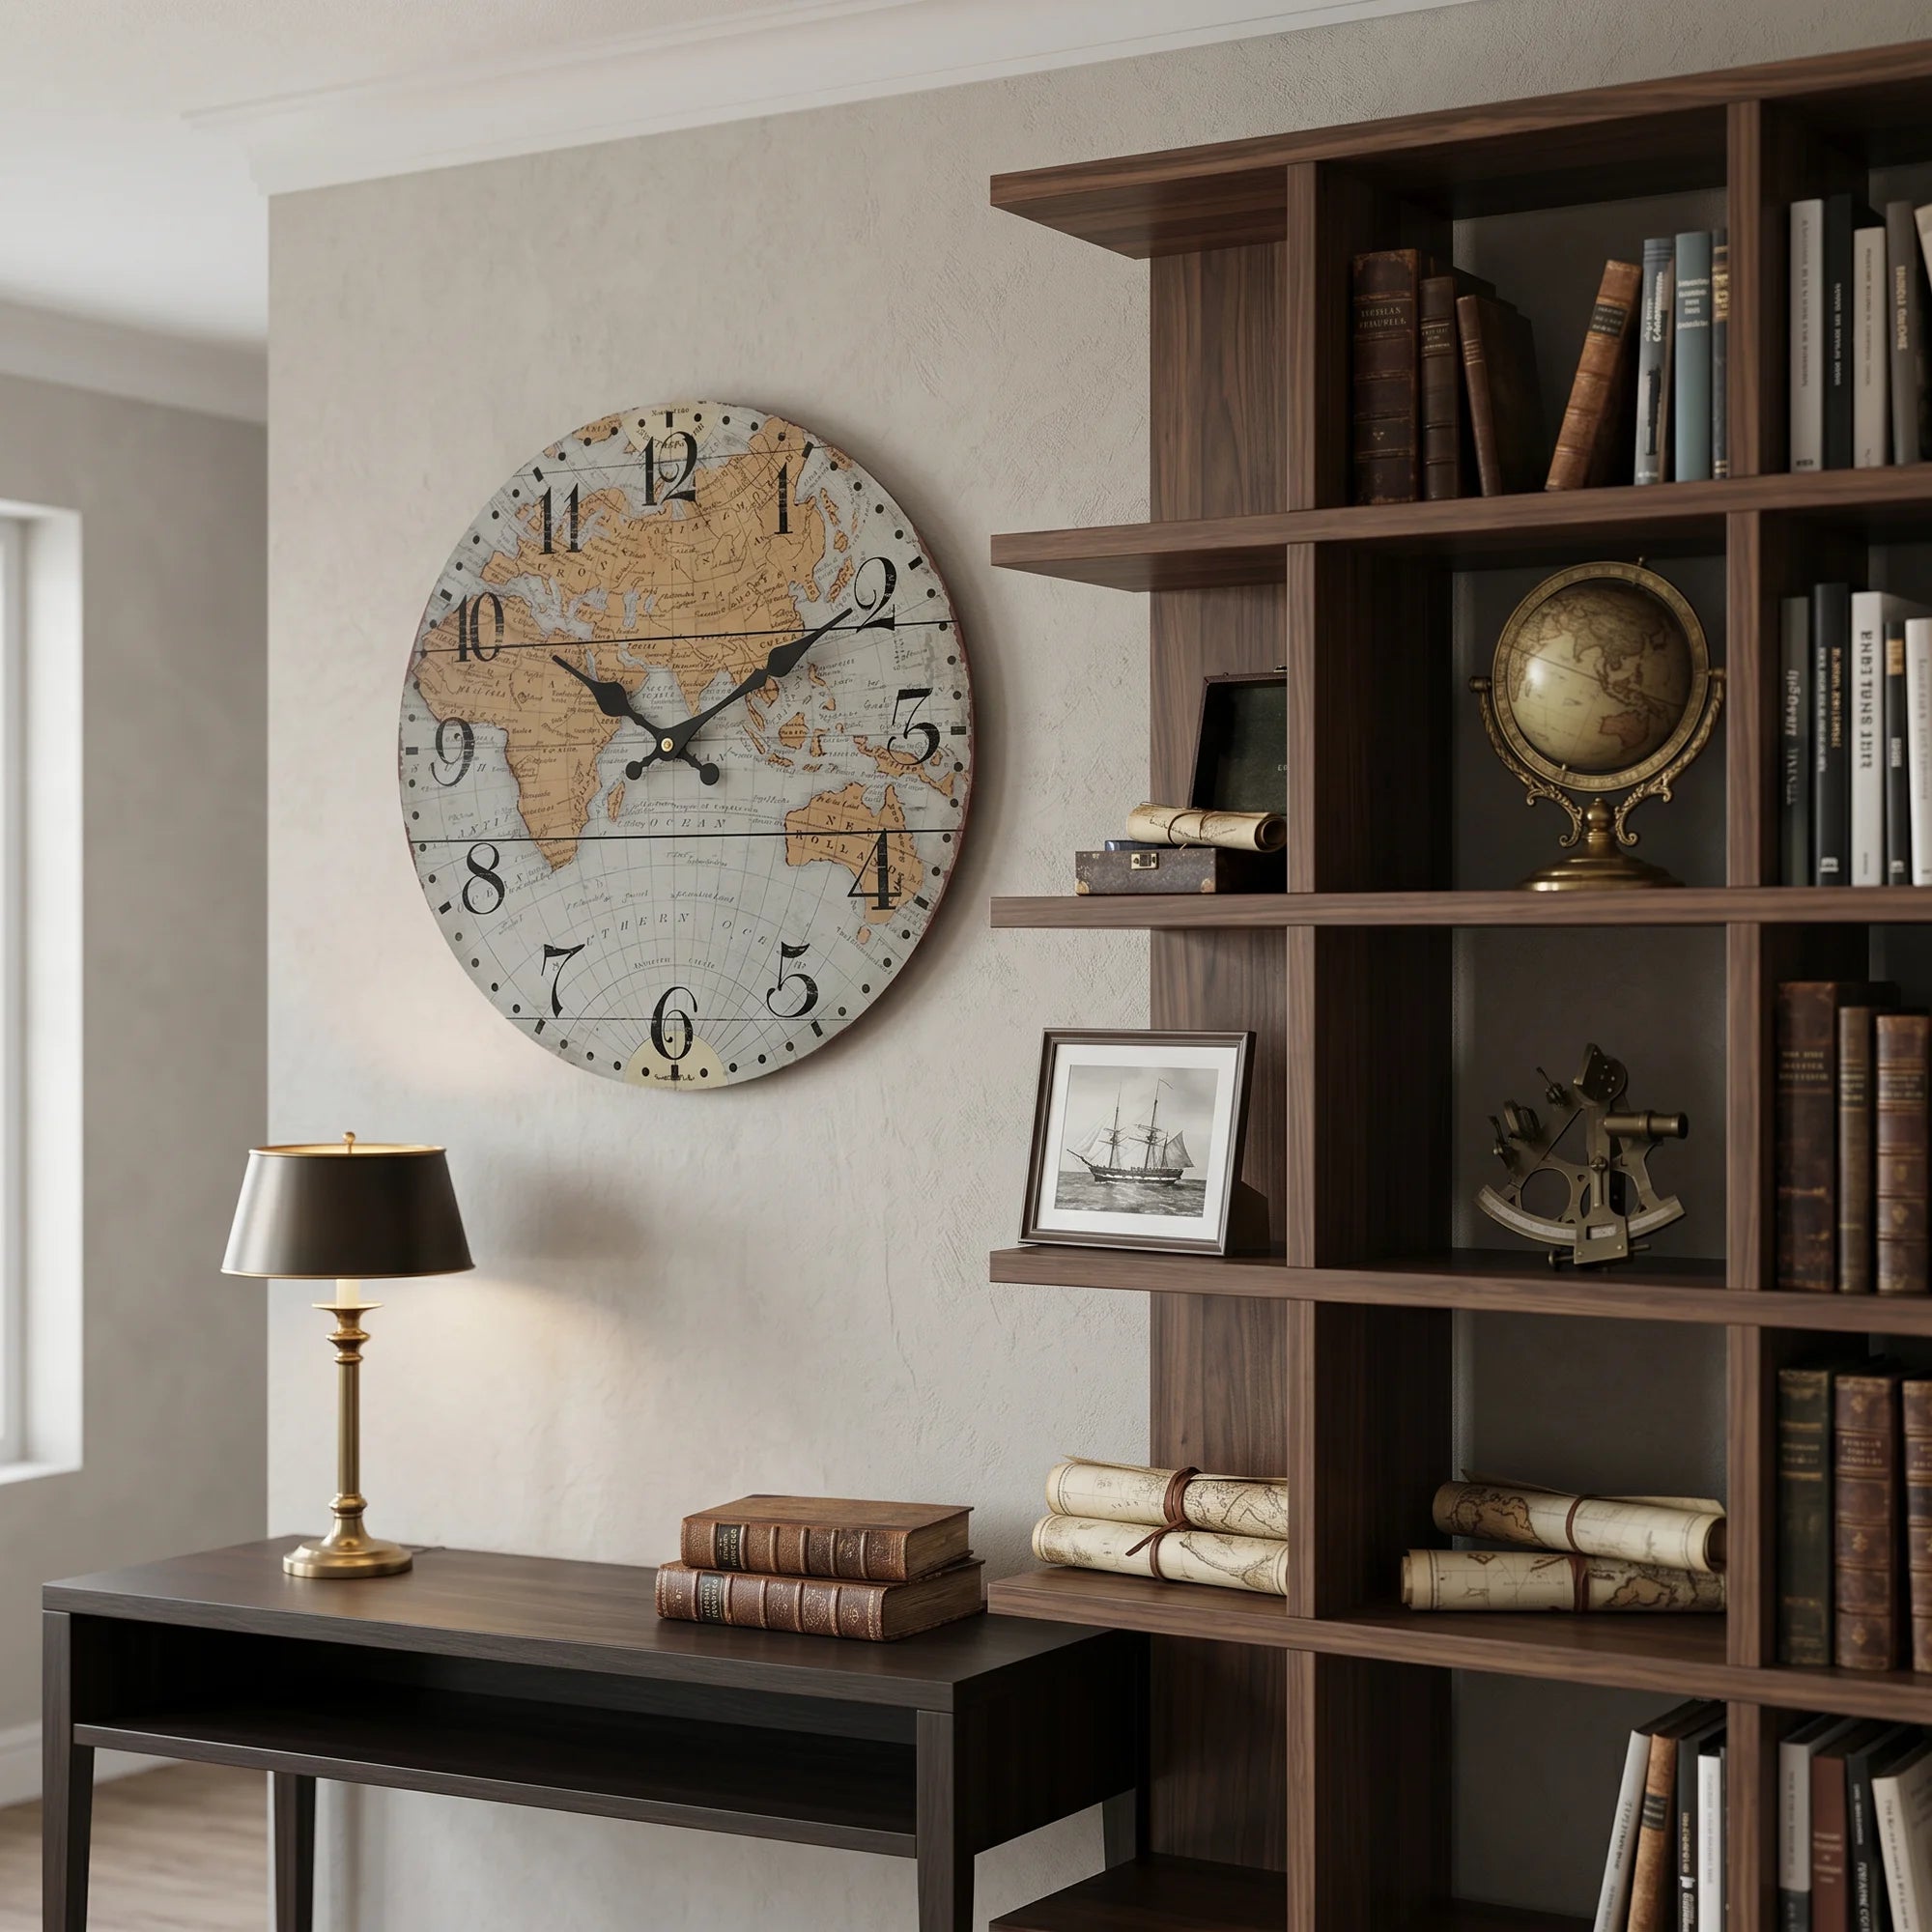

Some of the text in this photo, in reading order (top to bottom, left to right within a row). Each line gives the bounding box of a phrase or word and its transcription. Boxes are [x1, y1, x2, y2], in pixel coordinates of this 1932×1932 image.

[638, 431, 697, 507] 12
[774, 462, 793, 534] 1
[539, 483, 582, 554] 11
[452, 591, 504, 663] 10
[854, 556, 897, 634] 2
[431, 717, 474, 787] 9
[888, 687, 941, 766] 3
[462, 842, 505, 915] 8
[847, 828, 902, 911] 4
[541, 943, 585, 1018] 7
[766, 941, 818, 1018] 5
[651, 985, 697, 1061] 6
